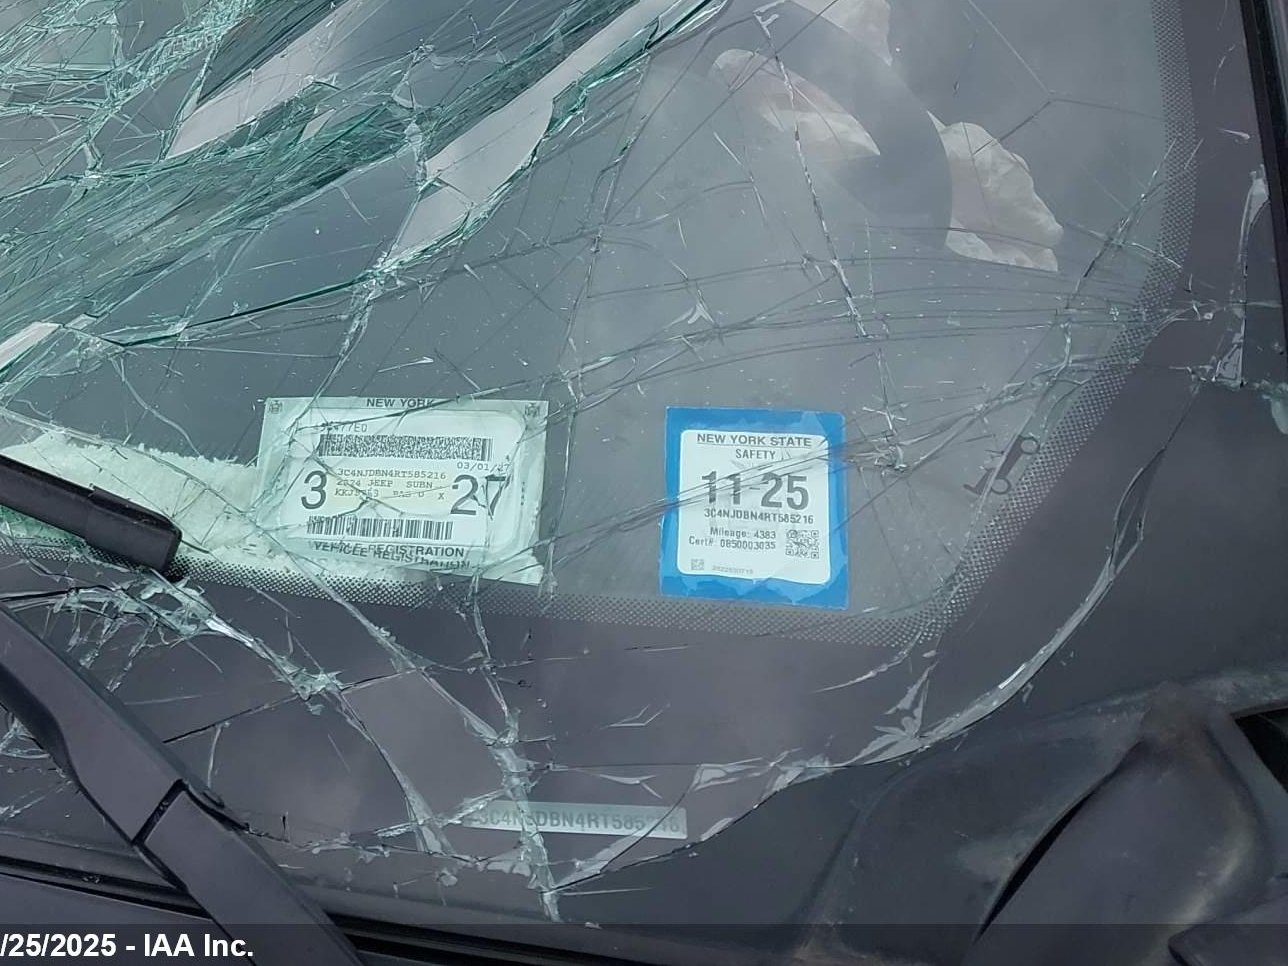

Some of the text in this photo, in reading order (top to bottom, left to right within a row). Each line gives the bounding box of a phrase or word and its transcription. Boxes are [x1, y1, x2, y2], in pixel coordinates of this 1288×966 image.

[367, 398, 434, 409] NEW YORK
[697, 433, 812, 447] NEW YORK STATE
[735, 448, 776, 460] SAFETY
[301, 470, 327, 510] 3
[368, 480, 393, 489] JEEP
[406, 481, 433, 490] SUBN
[451, 474, 509, 517] 27
[703, 508, 814, 524] 3C4NJDBN4RT585216
[710, 527, 776, 540] Mileage: 4383
[368, 544, 465, 557] REGISTRATION
